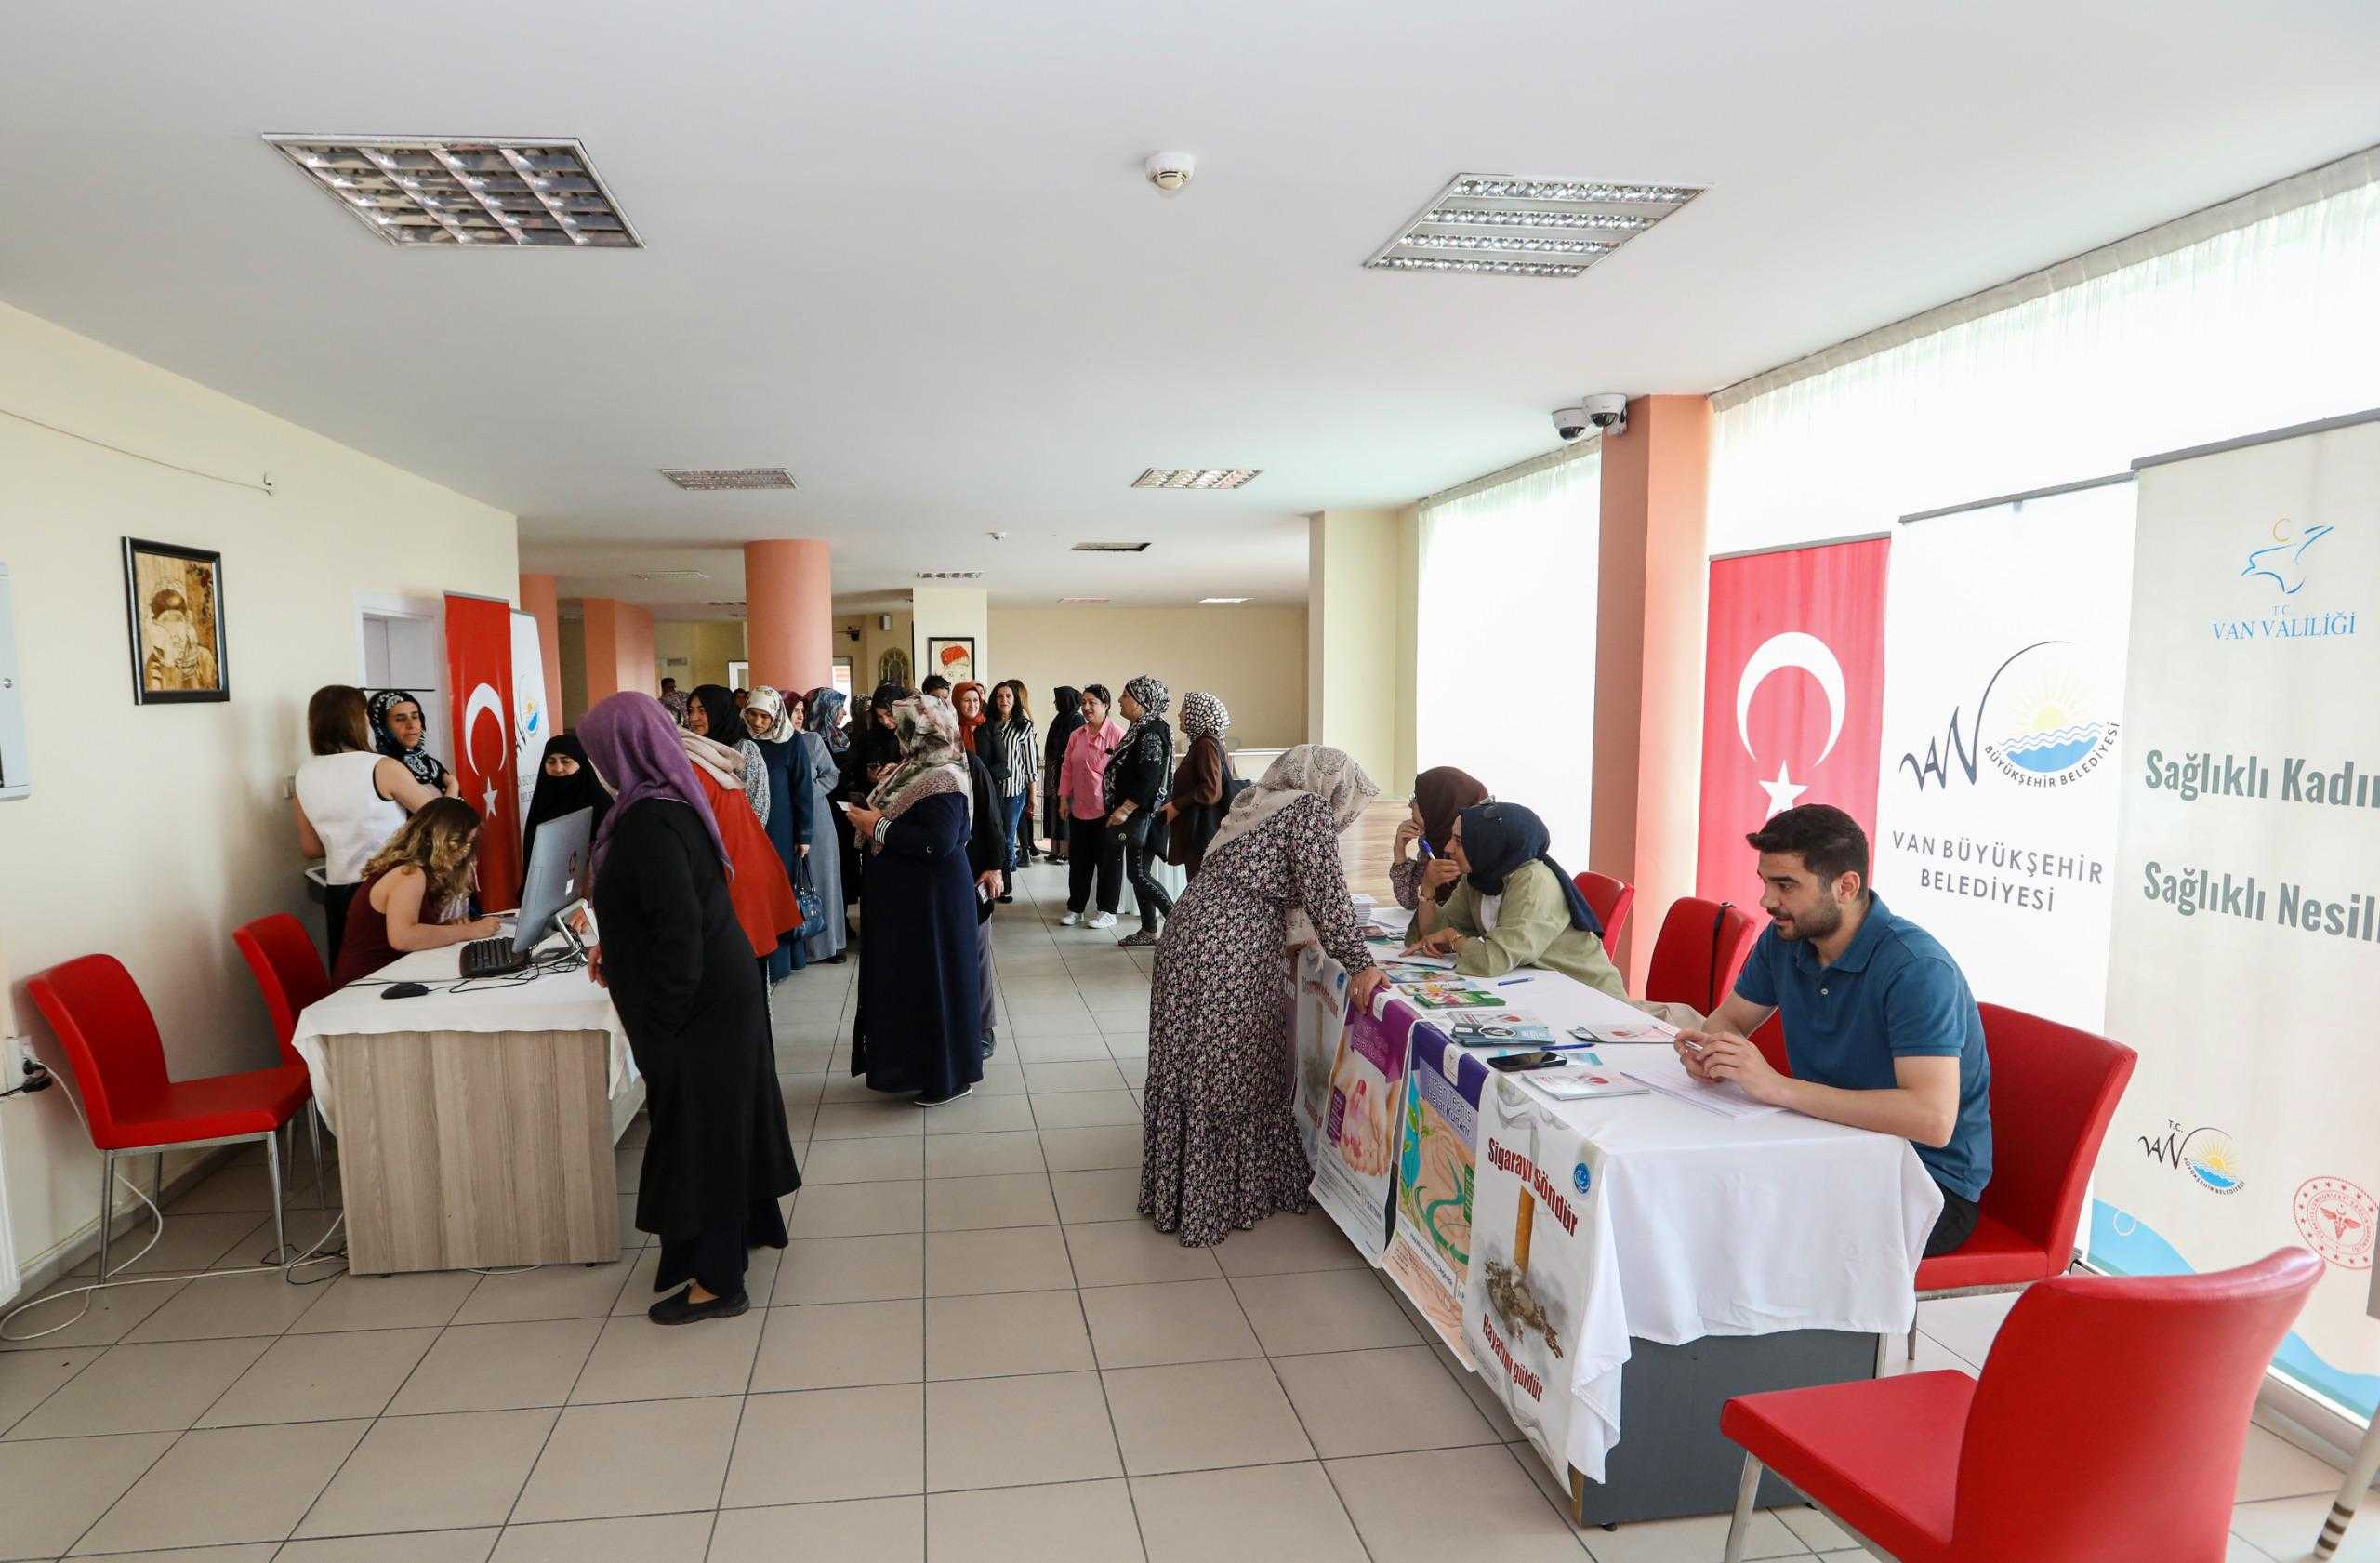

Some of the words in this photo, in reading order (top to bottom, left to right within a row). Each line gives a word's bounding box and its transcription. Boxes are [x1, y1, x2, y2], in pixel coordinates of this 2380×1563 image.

[2213, 620, 2254, 640] VAN
[2262, 611, 2357, 639] VALİLİĞİ
[1984, 744, 2056, 788] BÜYÜKŞEHİR
[2059, 721, 2121, 787] BELEDİYESİ
[2144, 749, 2268, 801] Sağlıklı
[1892, 830, 1935, 856] VAN
[1942, 836, 2103, 885] BÜYÜKŞEHİR
[1920, 868, 2055, 912] BELEDİYESİ
[2143, 861, 2266, 921] Sağlıklı
[2278, 882, 2380, 944] Nesil
[1488, 1137, 1534, 1183] Sigarayı
[1533, 1168, 1579, 1238] söndür
[1513, 1361, 1543, 1403] güldür
